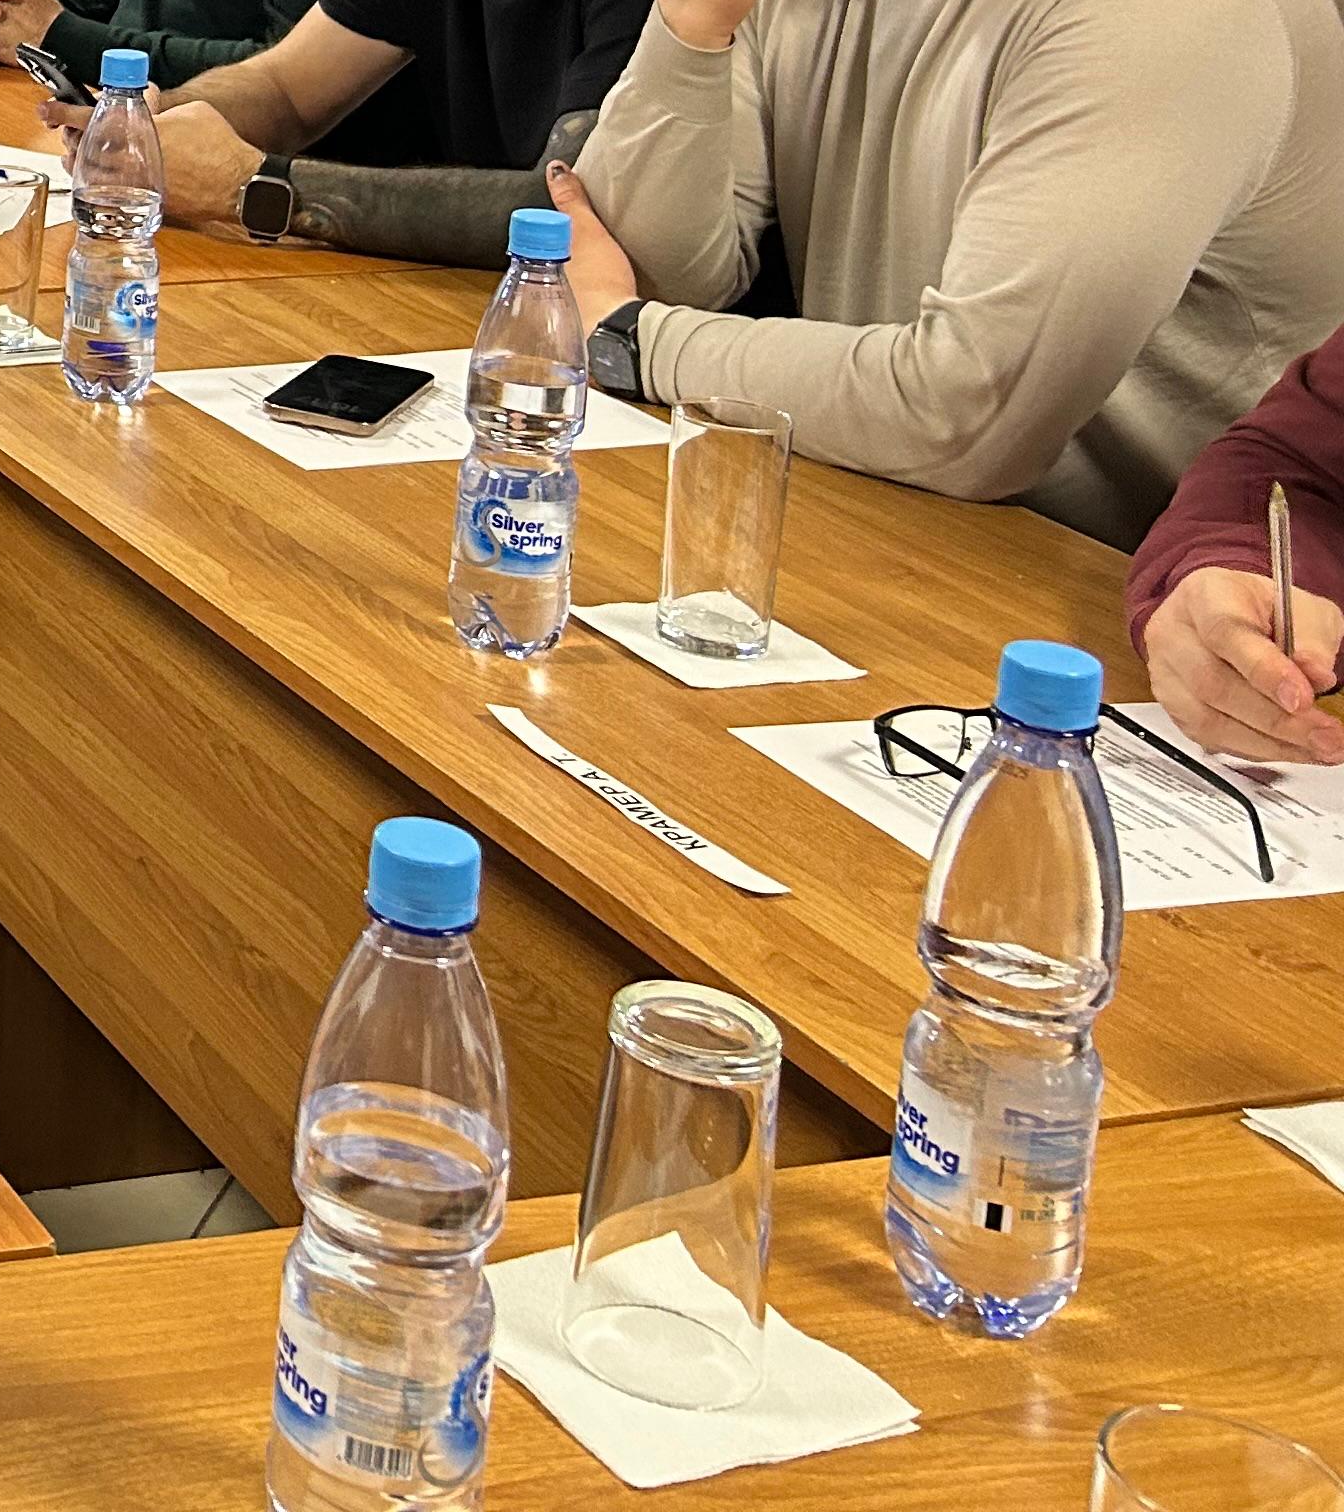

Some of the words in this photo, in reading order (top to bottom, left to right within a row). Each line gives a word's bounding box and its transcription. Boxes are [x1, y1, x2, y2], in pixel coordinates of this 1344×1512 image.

[491, 513, 544, 534] Silver
[509, 532, 563, 550] spring
[599, 784, 708, 851] КРАМЕР
